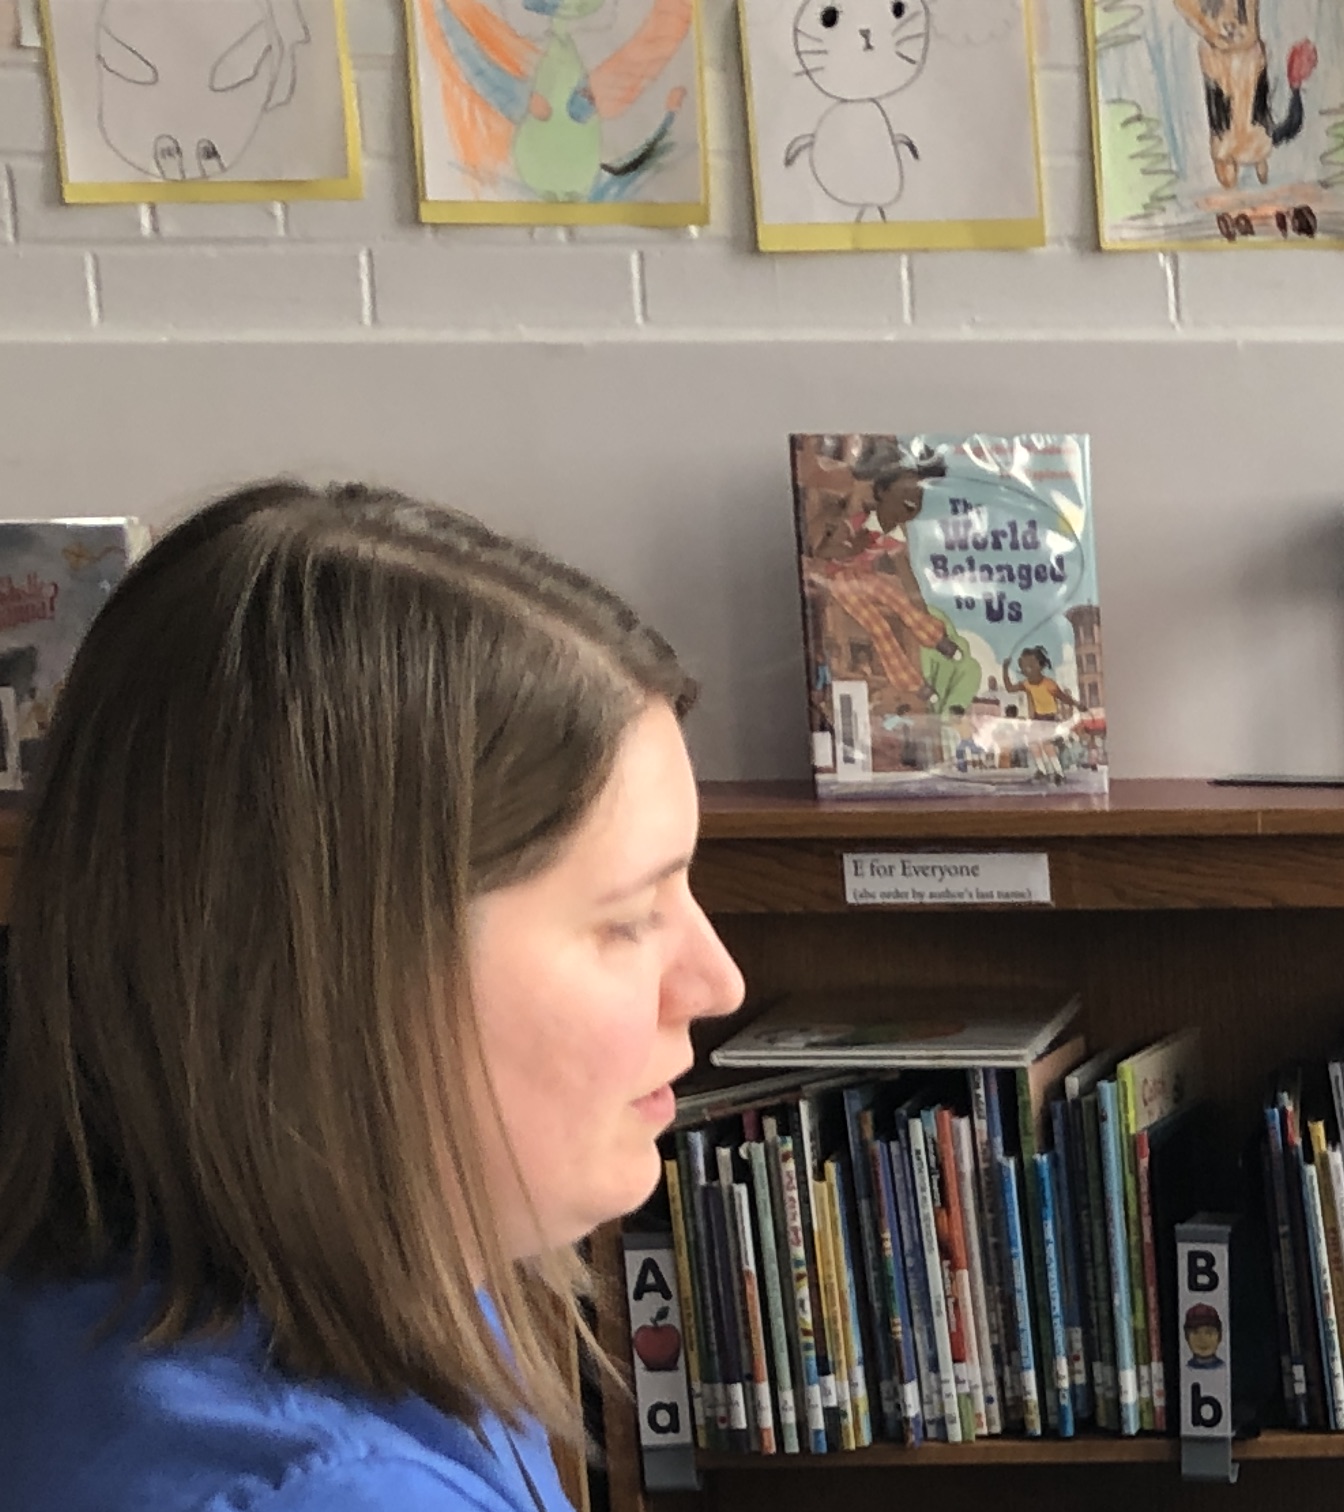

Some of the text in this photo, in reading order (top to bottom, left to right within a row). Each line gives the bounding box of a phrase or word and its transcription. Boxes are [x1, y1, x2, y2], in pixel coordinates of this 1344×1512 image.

[939, 519, 1041, 551] World
[930, 553, 1067, 591] Belonged
[983, 591, 1024, 623] Us
[852, 858, 980, 882] E for Everyone
[633, 1258, 672, 1302] A
[1188, 1251, 1220, 1292] B
[647, 1400, 681, 1435] a
[1191, 1384, 1224, 1429] b
